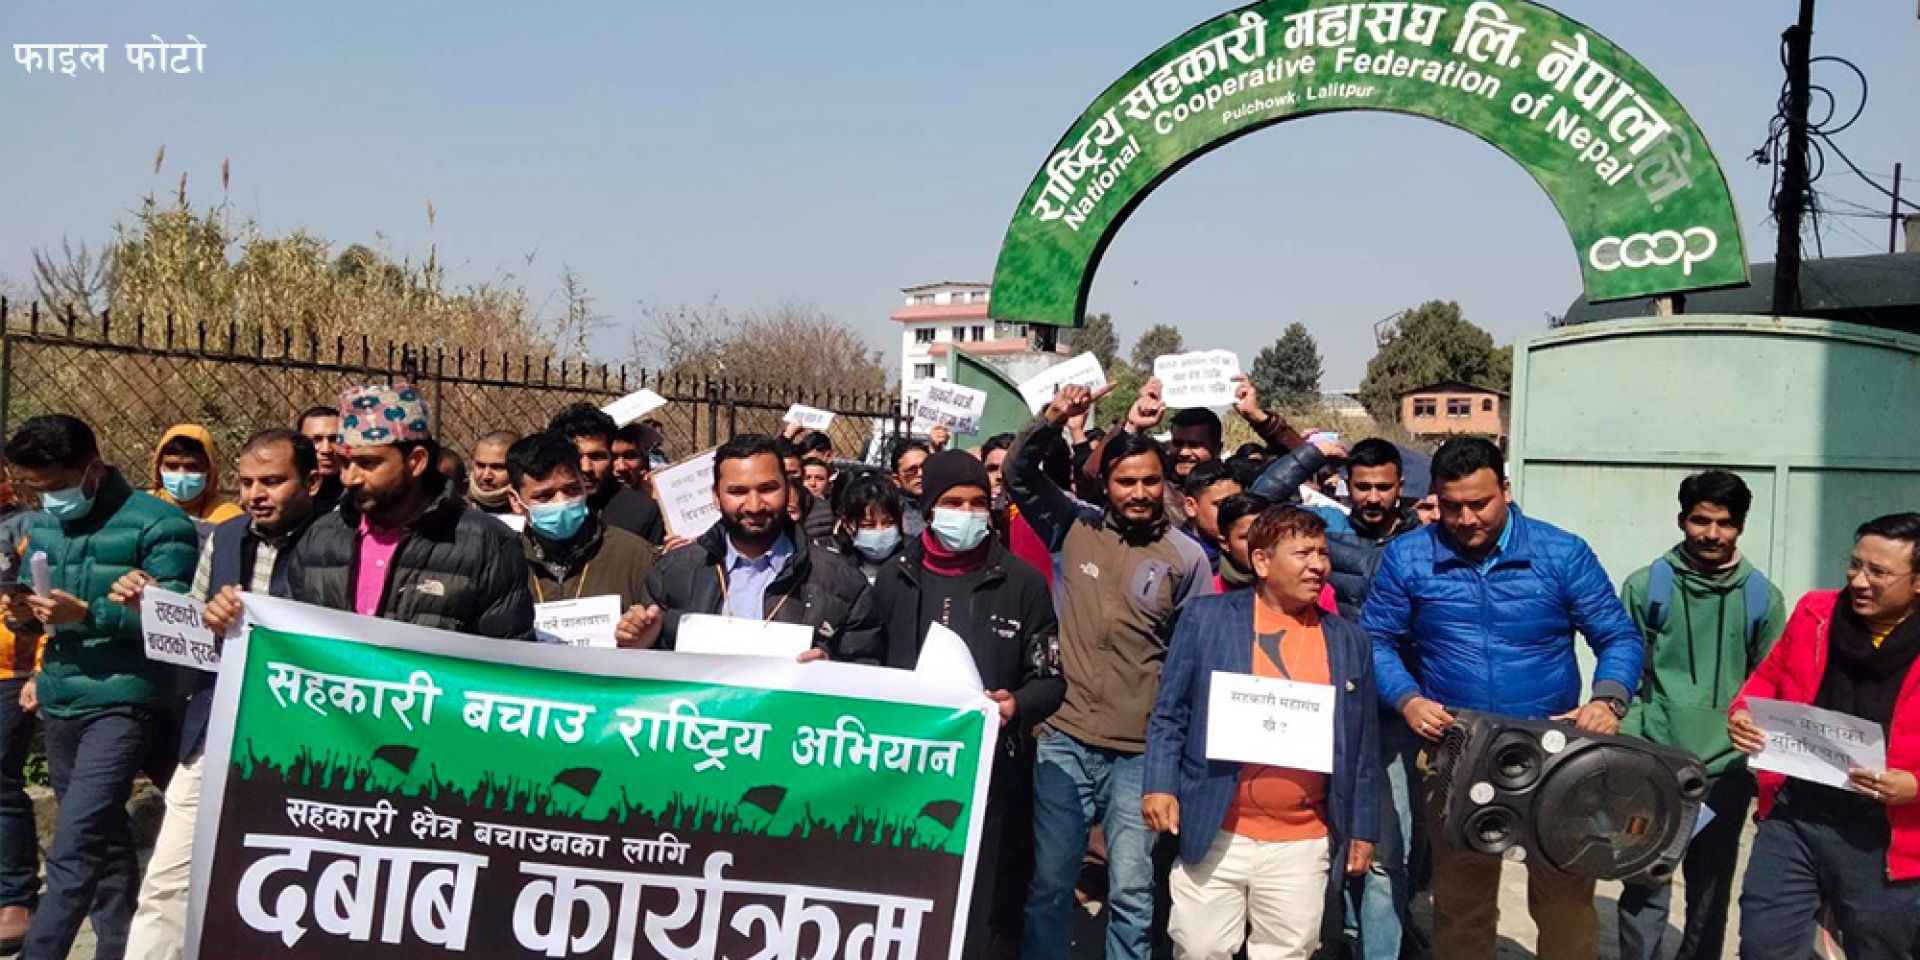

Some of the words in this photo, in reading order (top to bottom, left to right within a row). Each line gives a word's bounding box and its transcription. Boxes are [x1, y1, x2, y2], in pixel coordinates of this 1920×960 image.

[1119, 11, 1268, 120] सहकारी
[1536, 32, 1673, 155] नेपाल
[1306, 83, 1375, 100] Lalitpur
[1063, 134, 1141, 231] National
[1154, 55, 1315, 135] Cooperative
[1335, 48, 1501, 98] Federation
[1511, 92, 1553, 120] of
[1545, 106, 1634, 187] Nepal
[147, 632, 187, 657] बचतको
[155, 601, 199, 628] सहकारी
[267, 662, 442, 731] सहकारी
[462, 691, 596, 744] बचाउ
[616, 698, 772, 772] राष्ट्रिय
[792, 716, 965, 777] अभियान
[1230, 691, 1275, 706] सहकारी
[286, 798, 397, 838] सहकारी
[411, 806, 461, 840] क्षेत्र
[474, 821, 610, 857] बचाउनका
[621, 833, 691, 864] लागि
[237, 833, 489, 951] दबाब
[512, 851, 933, 960] कार्यक्रम
